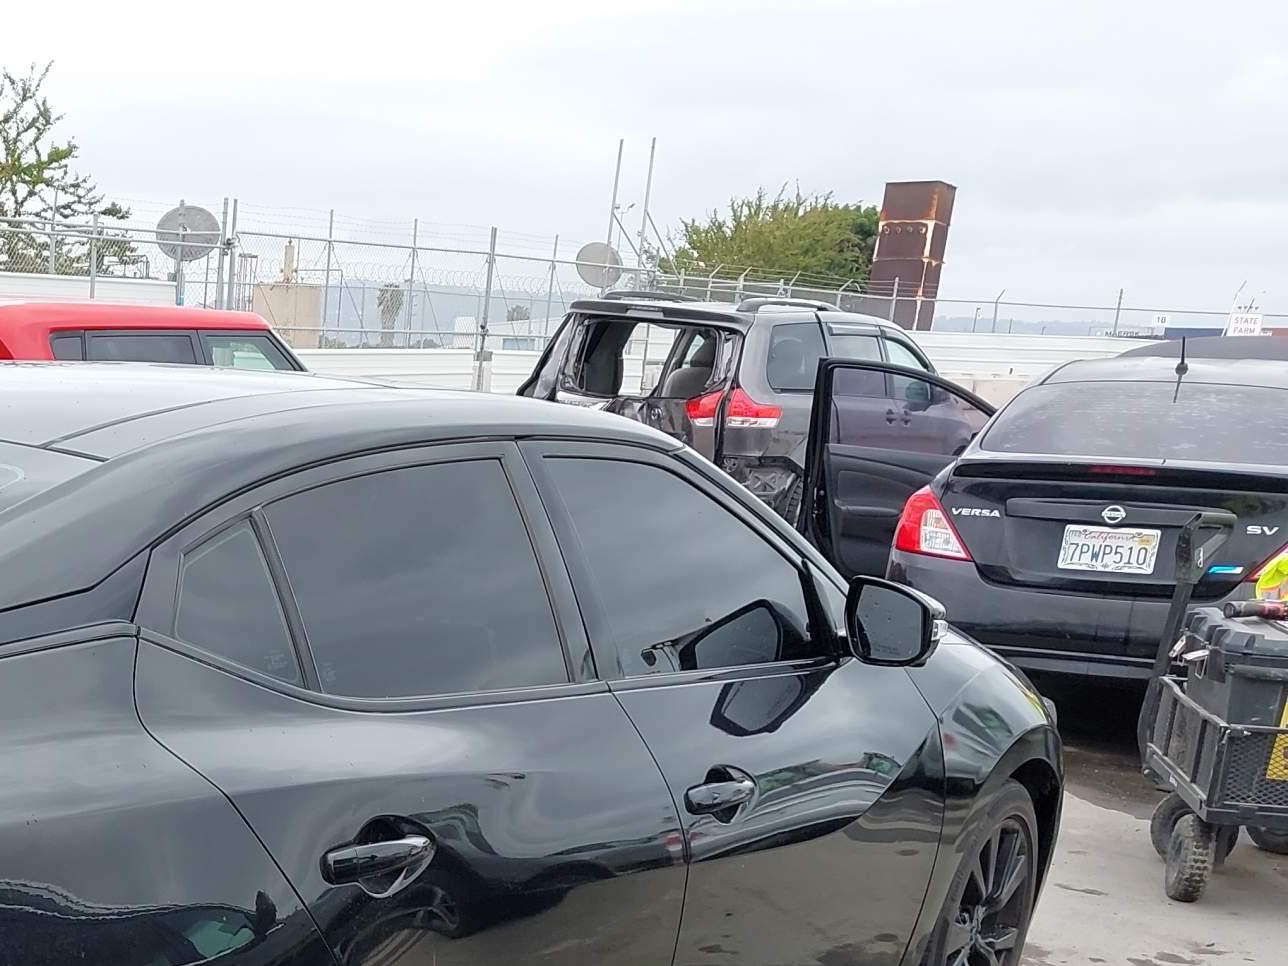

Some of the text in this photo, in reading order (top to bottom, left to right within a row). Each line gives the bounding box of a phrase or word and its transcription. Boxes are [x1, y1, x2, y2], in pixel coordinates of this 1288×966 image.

[1234, 317, 1258, 325] STATE
[951, 507, 1000, 518] VERSA
[1246, 525, 1279, 536] SV
[1069, 542, 1149, 566] 7PWP510
